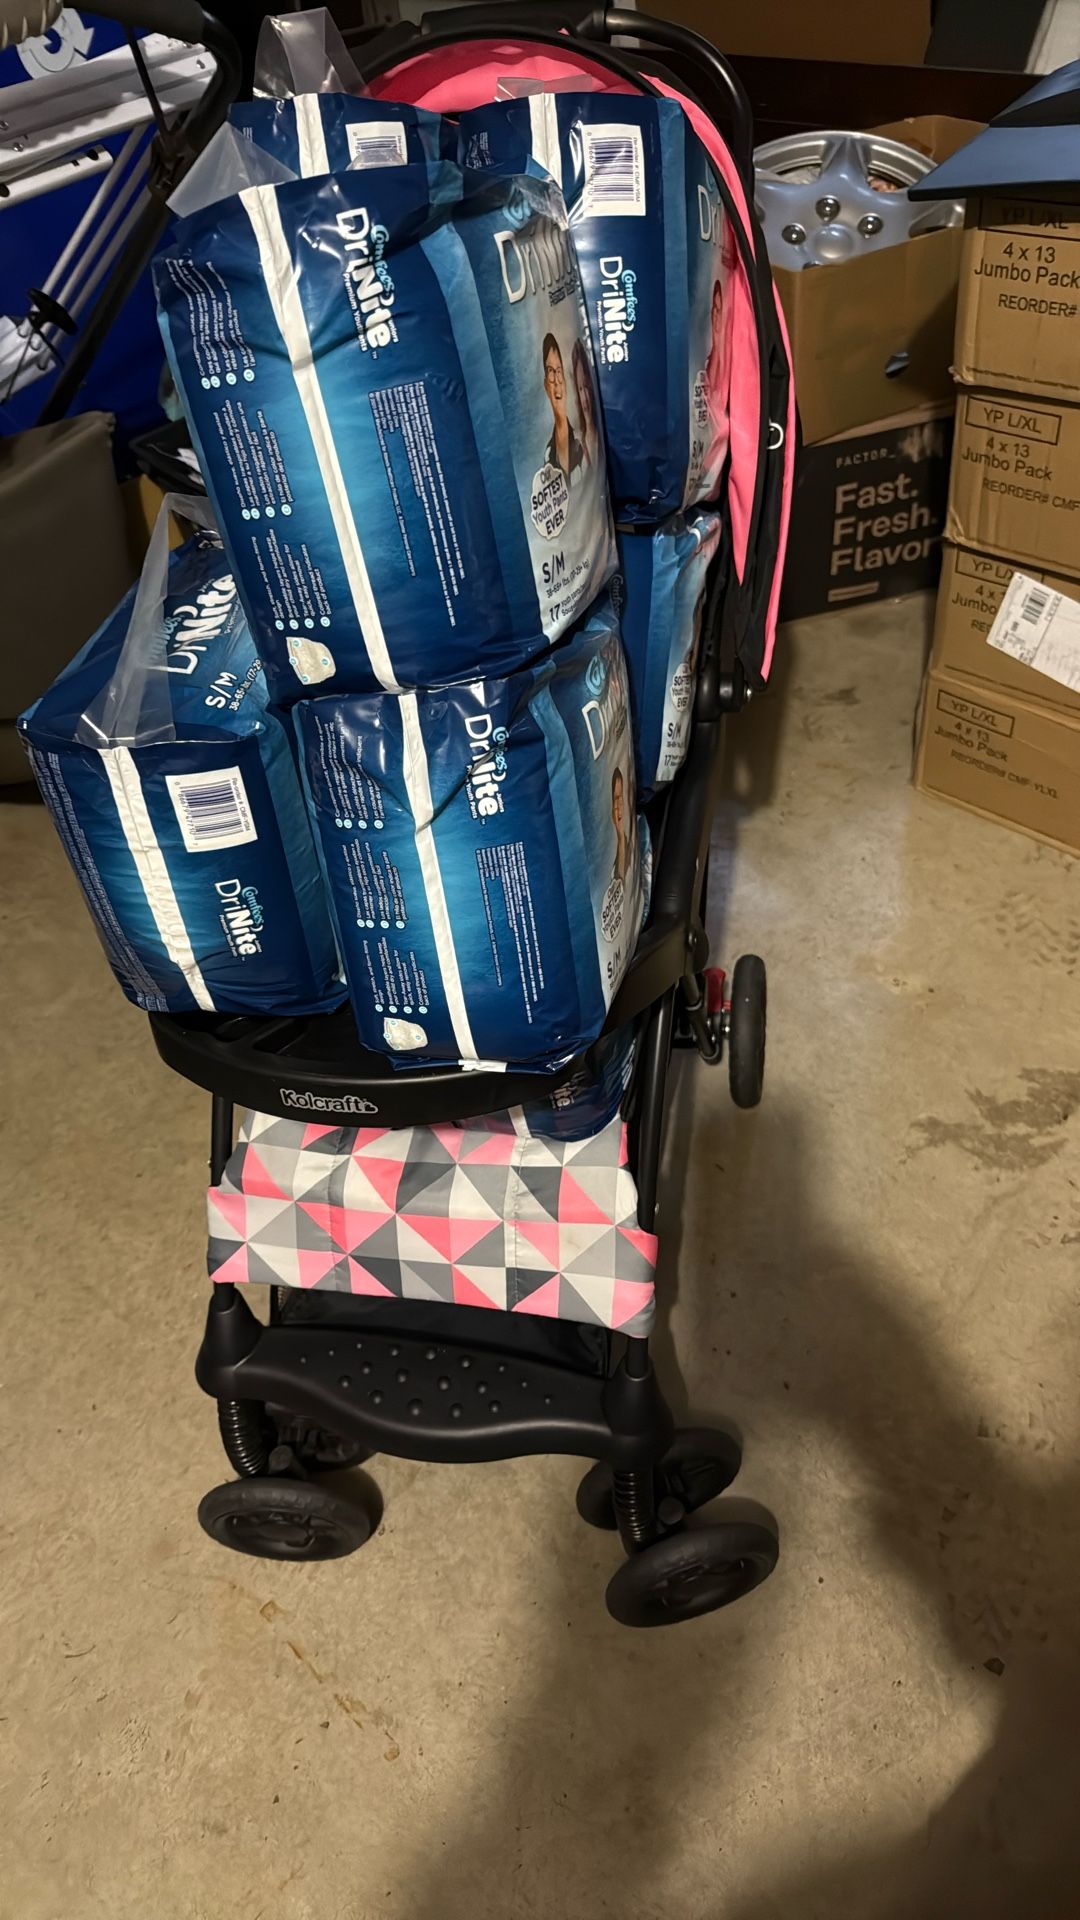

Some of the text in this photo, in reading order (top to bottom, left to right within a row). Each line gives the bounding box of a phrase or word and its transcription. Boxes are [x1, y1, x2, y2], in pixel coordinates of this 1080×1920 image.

[370, 224, 395, 292] Comfees
[1002, 242, 1056, 264] 4 x 13
[336, 207, 392, 348] DriNite
[974, 258, 1080, 289] Jumbo Pack
[342, 272, 358, 310] Premium
[622, 270, 638, 322] Comfees
[596, 300, 604, 328] Premium
[600, 256, 626, 363] DriNite
[998, 294, 1078, 317] REORDER#
[983, 407, 1042, 434] YP L/XL
[986, 436, 1030, 458] 4 x 13
[540, 466, 552, 485] Our
[962, 447, 1053, 482] Jumbo Pack
[532, 474, 564, 511] SOFTEST
[835, 473, 919, 514] Fast.
[982, 477, 1050, 504] REORDER#
[532, 490, 568, 525] Youth Pants
[546, 509, 565, 536] EVER
[833, 503, 938, 546] Fresh.
[301, 544, 312, 571] indicates
[542, 550, 565, 584] S/M
[972, 559, 992, 574] YP
[314, 568, 325, 593] product
[975, 586, 984, 596] 4
[987, 590, 995, 600] x
[315, 592, 325, 616] Colored
[549, 602, 560, 622] 17
[952, 592, 997, 614] Jumbo
[204, 670, 239, 710] S/M
[951, 700, 998, 727] YP L/XL
[934, 726, 1008, 762] Jumbo Pack
[976, 729, 990, 743] 13
[466, 784, 474, 802] Youth
[470, 802, 478, 819] Pants
[496, 792, 505, 814] Juniors
[214, 878, 257, 955] DriNite
[242, 886, 264, 926] Comfees
[280, 1088, 362, 1113] Kolcraft
